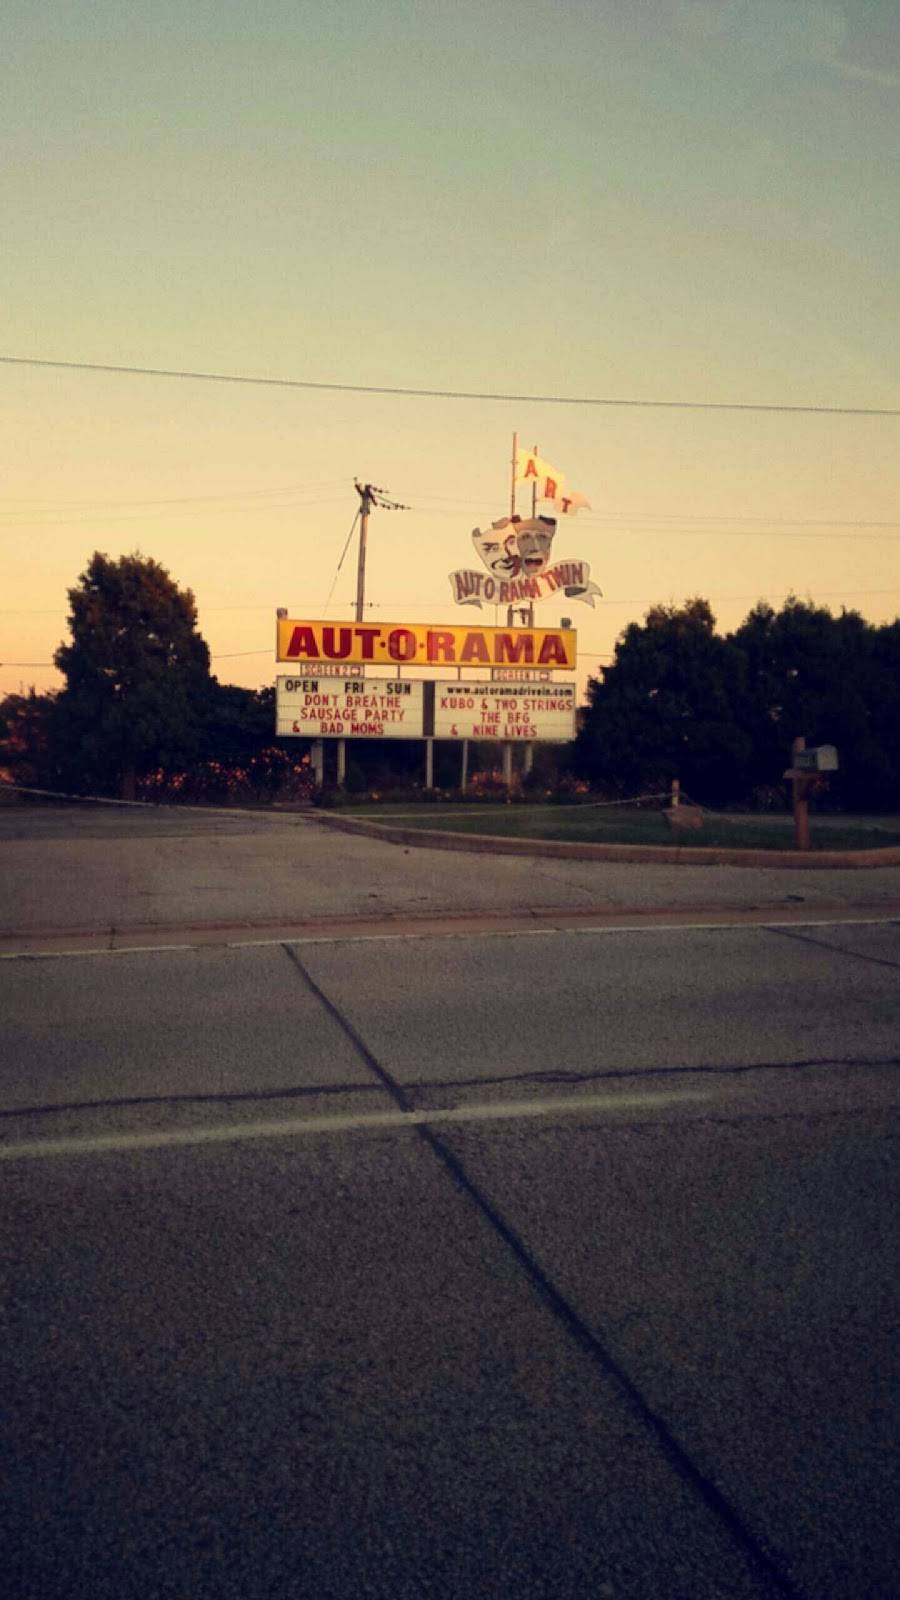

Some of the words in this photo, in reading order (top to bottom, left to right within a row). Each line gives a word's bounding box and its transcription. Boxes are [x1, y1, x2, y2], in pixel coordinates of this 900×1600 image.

[499, 576, 542, 602] RAMA
[540, 562, 584, 591] TWIN
[285, 680, 319, 693] OPEN
[344, 682, 364, 694] FRI
[386, 682, 411, 695] SUN
[346, 695, 401, 708] BREATHE
[440, 697, 475, 709] KUBO
[481, 698, 488, 710] &
[495, 699, 518, 711] TWO
[523, 699, 573, 711] STRINGS
[300, 708, 358, 720] SAUSAGE
[364, 709, 405, 721] PARTY
[480, 711, 501, 723] THE
[507, 712, 530, 723] BFG
[292, 721, 300, 733] &
[320, 722, 344, 734] BAD
[351, 722, 384, 735] MOMS
[450, 724, 458, 736] &
[472, 725, 498, 736] NINE
[504, 726, 538, 737] LIVES
